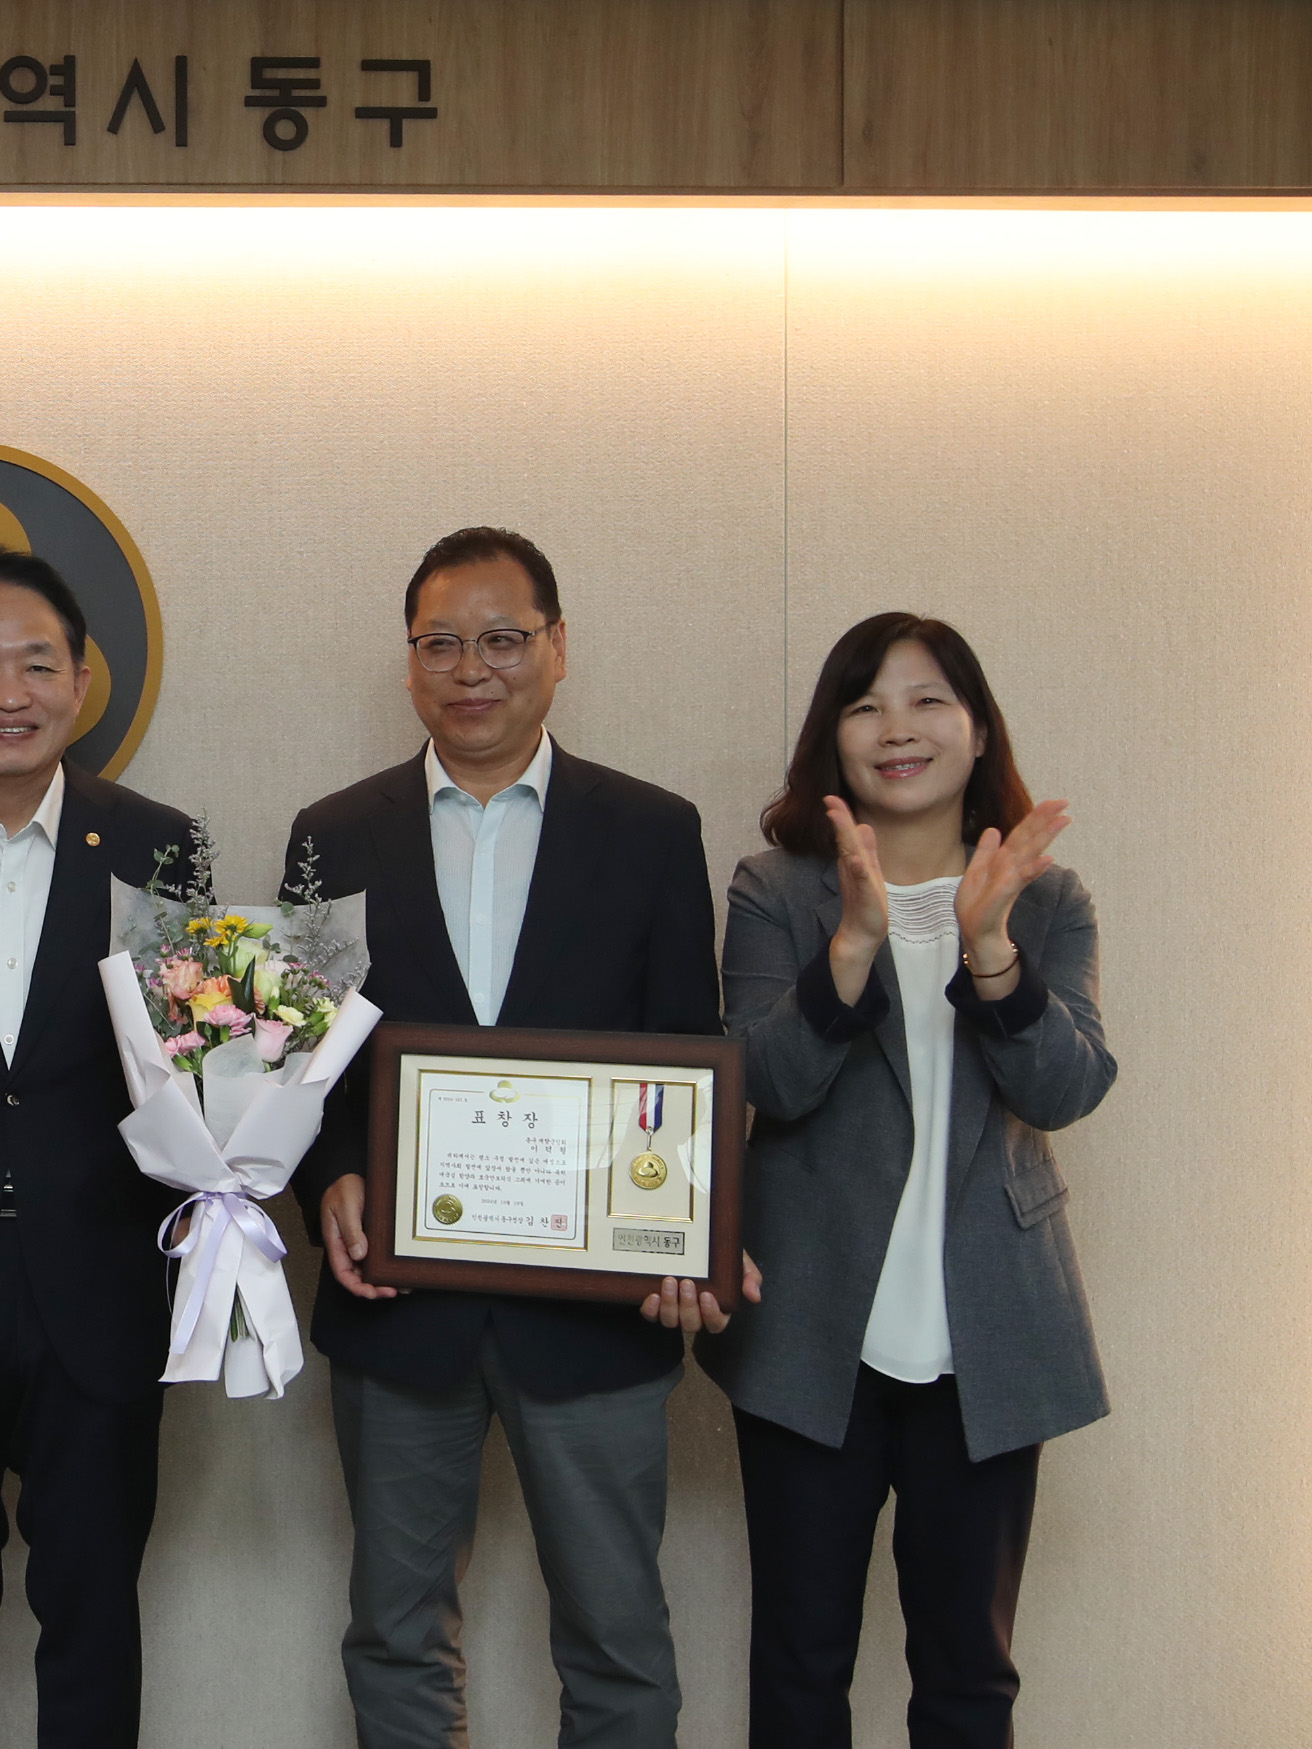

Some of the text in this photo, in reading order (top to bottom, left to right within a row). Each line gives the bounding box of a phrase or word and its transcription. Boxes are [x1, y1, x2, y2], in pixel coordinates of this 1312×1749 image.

[244, 56, 438, 152] 동구
[617, 1233, 680, 1249] 인천광역시 동구
